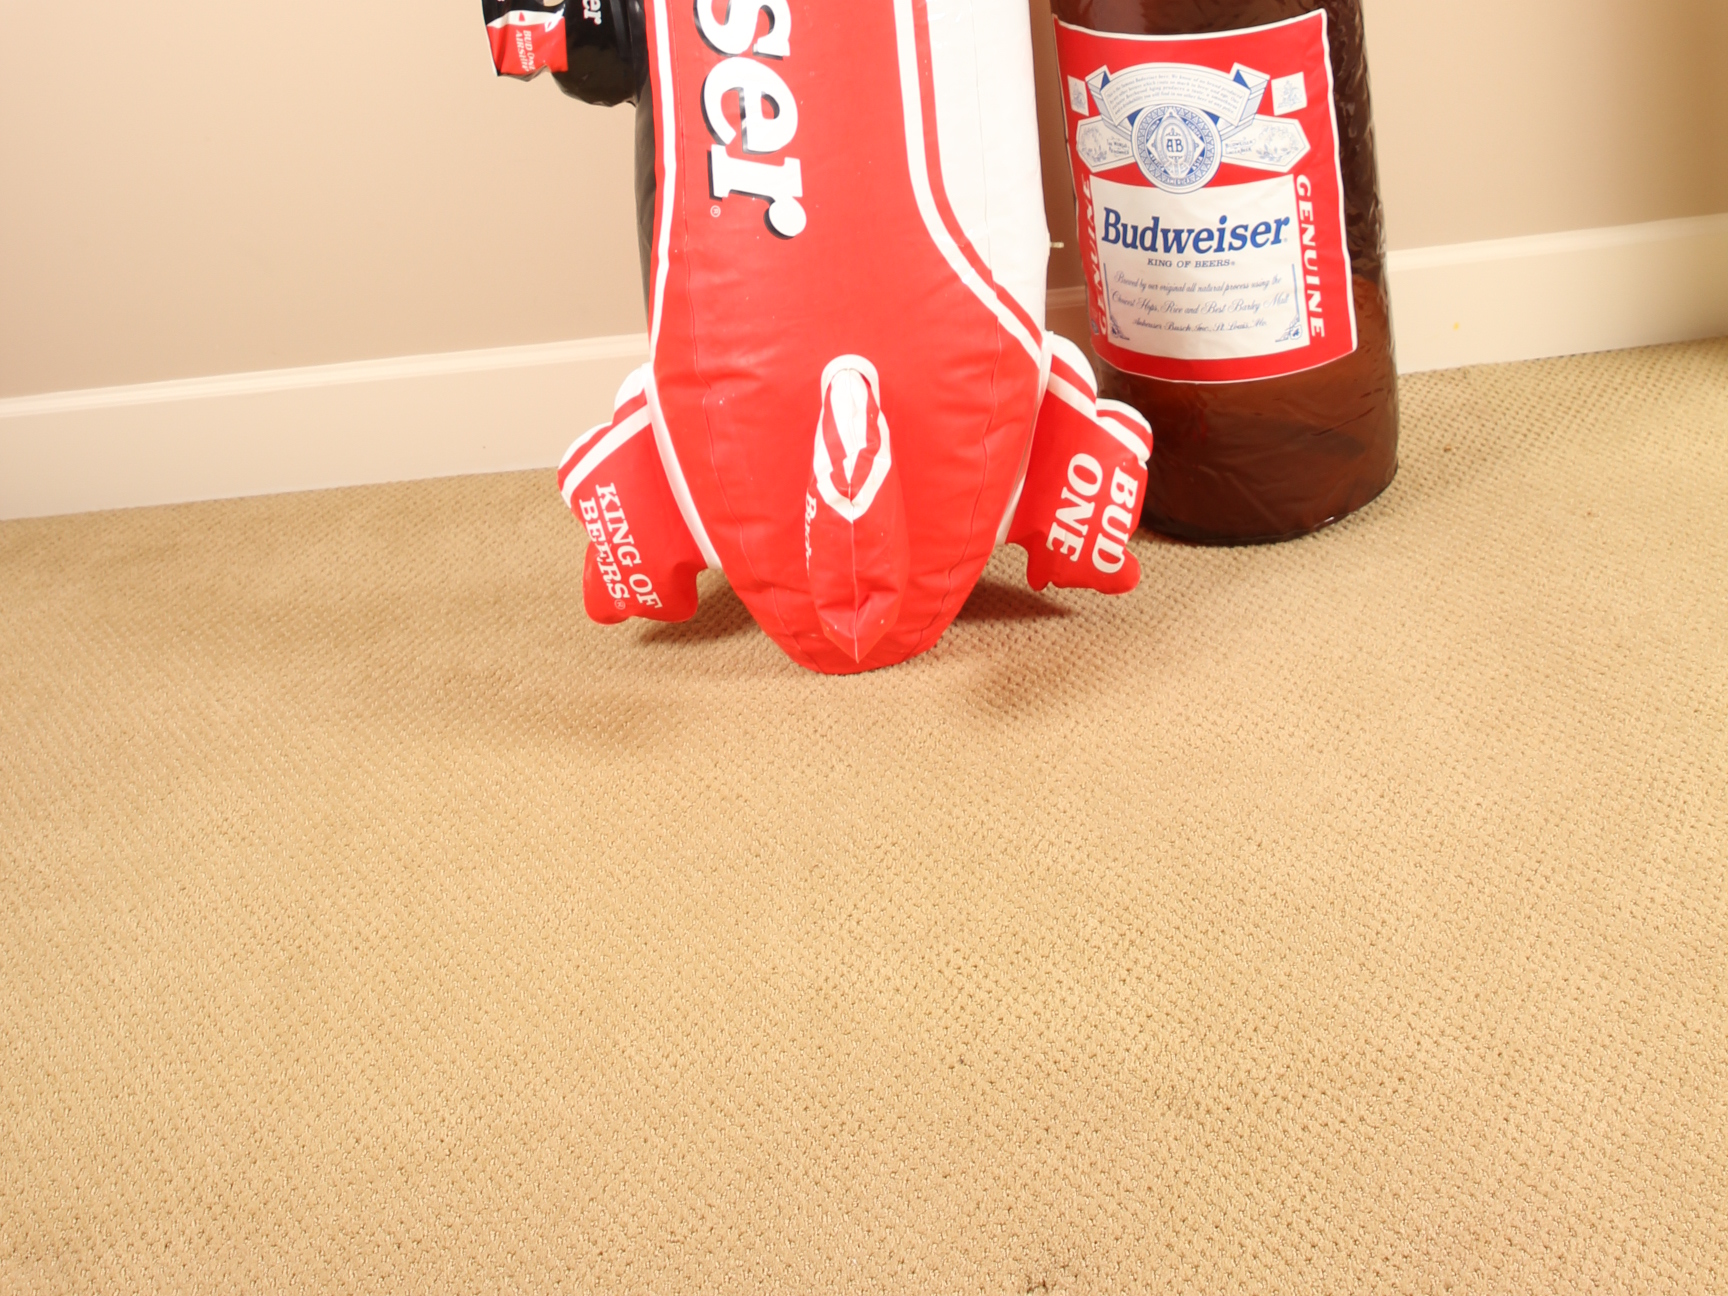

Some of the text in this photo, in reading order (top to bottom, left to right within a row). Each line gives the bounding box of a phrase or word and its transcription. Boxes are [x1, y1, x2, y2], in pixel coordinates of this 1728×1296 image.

[523, 29, 533, 51] BUD
[1165, 138, 1184, 153] AB
[1081, 173, 1108, 337] GENUINE
[1101, 207, 1289, 254] Budweiser
[1147, 258, 1172, 268] KING
[1176, 259, 1191, 268] OF
[1296, 174, 1325, 338] GENUINE
[1160, 282, 1186, 296] original
[1186, 283, 1197, 292] all
[1197, 281, 1225, 292] natural
[1222, 283, 1250, 296] process
[1184, 304, 1200, 314] and
[1201, 301, 1227, 314] Best
[1227, 299, 1261, 314] Barley
[1045, 452, 1104, 563] ONE
[1091, 465, 1138, 574] BUD
[579, 498, 630, 600] BEERS
[596, 483, 662, 610] KING OF
